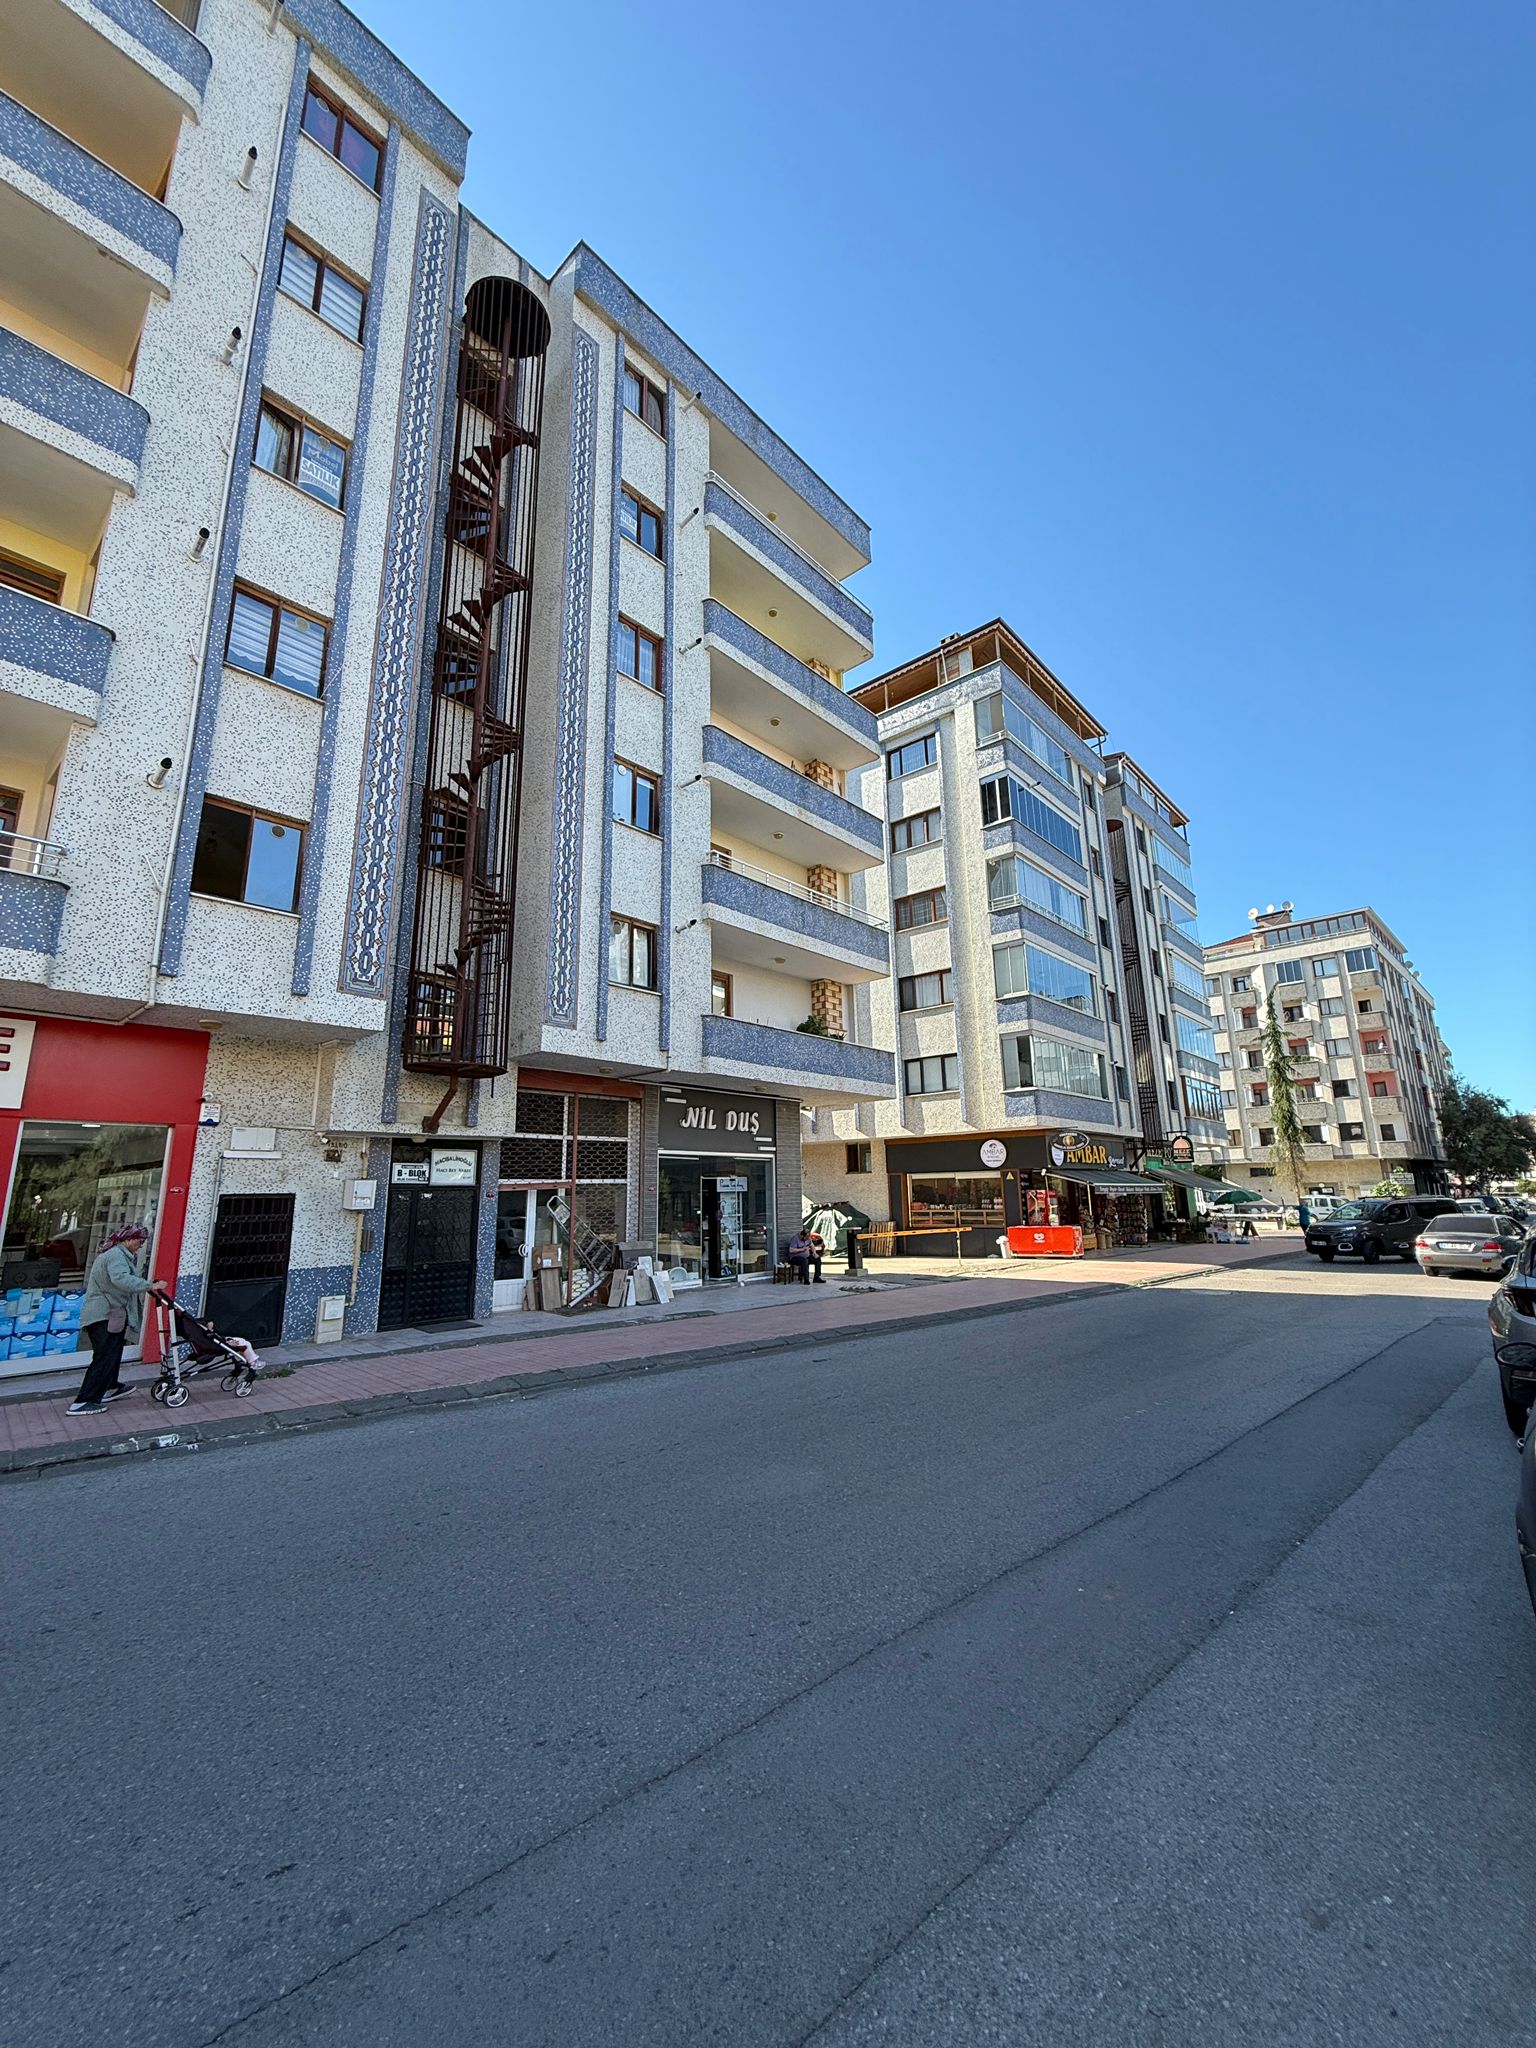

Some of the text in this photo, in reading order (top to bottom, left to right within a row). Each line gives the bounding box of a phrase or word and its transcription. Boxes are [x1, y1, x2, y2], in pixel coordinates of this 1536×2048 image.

[302, 460, 338, 488] SATILIK
[726, 1110, 759, 1135] DUŞ
[1066, 1144, 1107, 1164] AMBAR
[397, 1169, 403, 1177] B
[408, 1169, 427, 1178] BLOK
